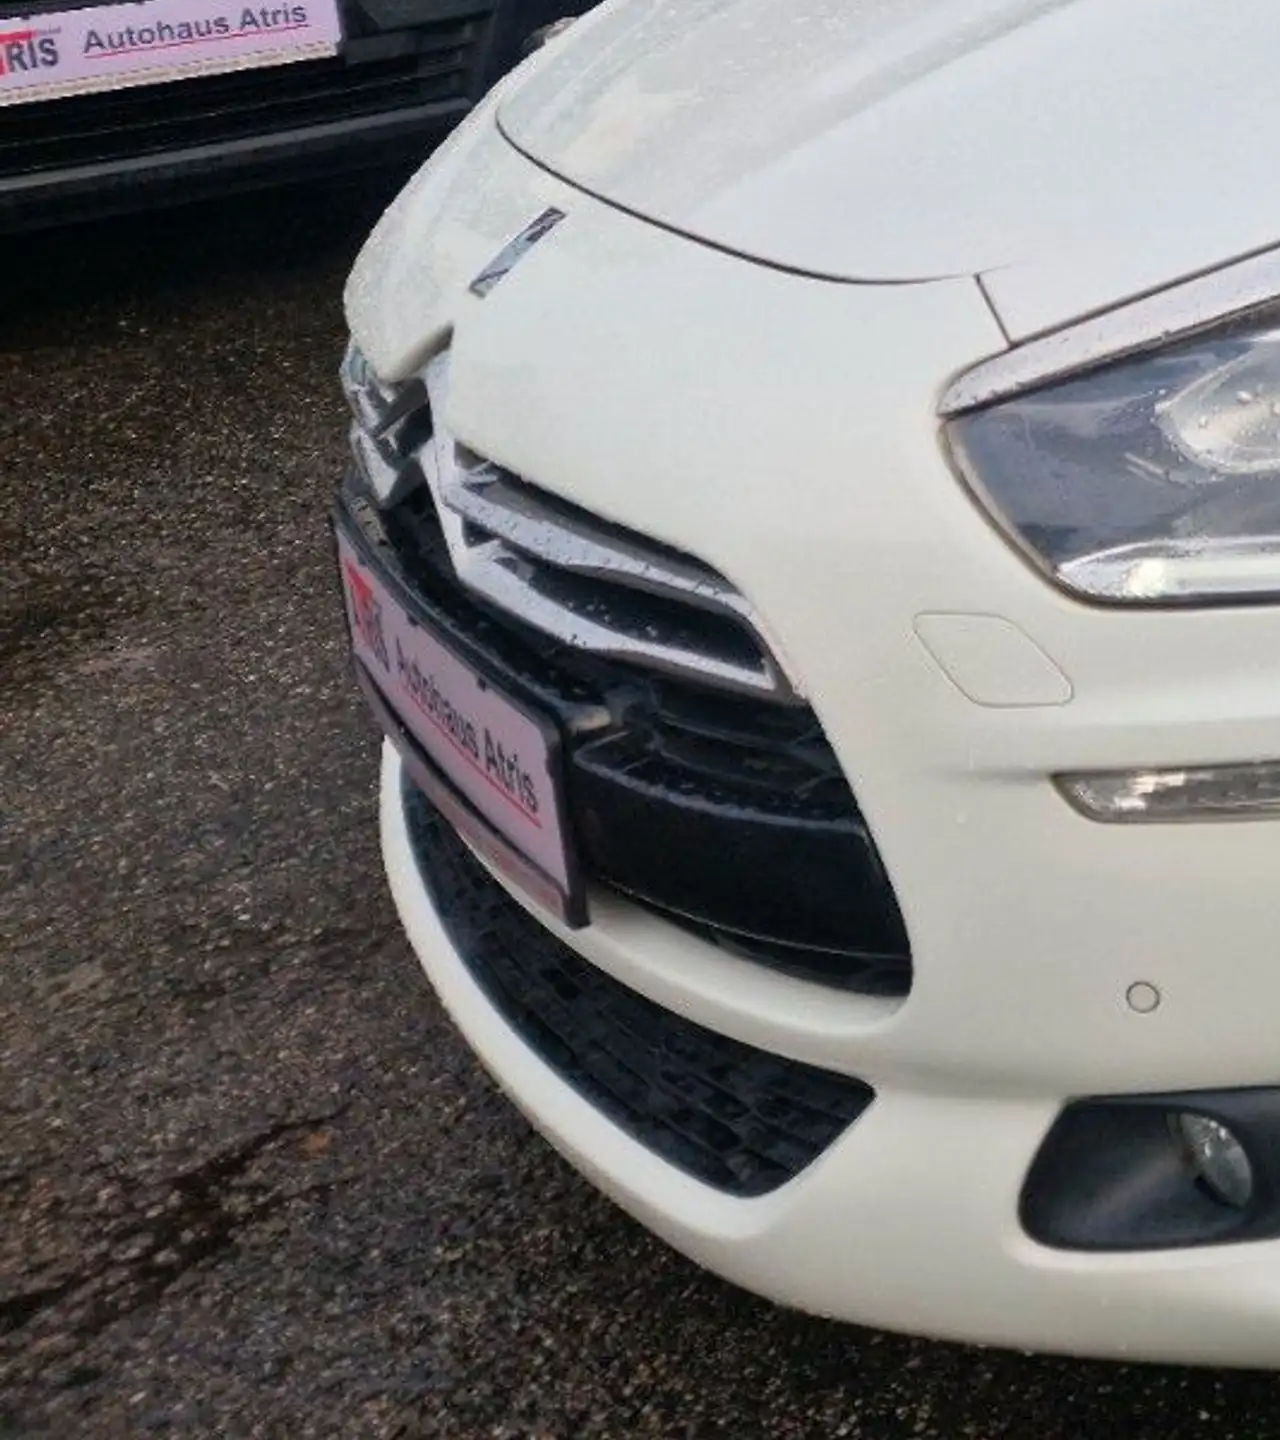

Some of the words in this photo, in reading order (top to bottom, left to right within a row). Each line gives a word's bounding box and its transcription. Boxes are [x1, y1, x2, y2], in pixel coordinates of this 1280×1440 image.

[84, 15, 230, 54] Autohaus
[239, 2, 307, 30] Atris
[484, 727, 540, 814] Atris
